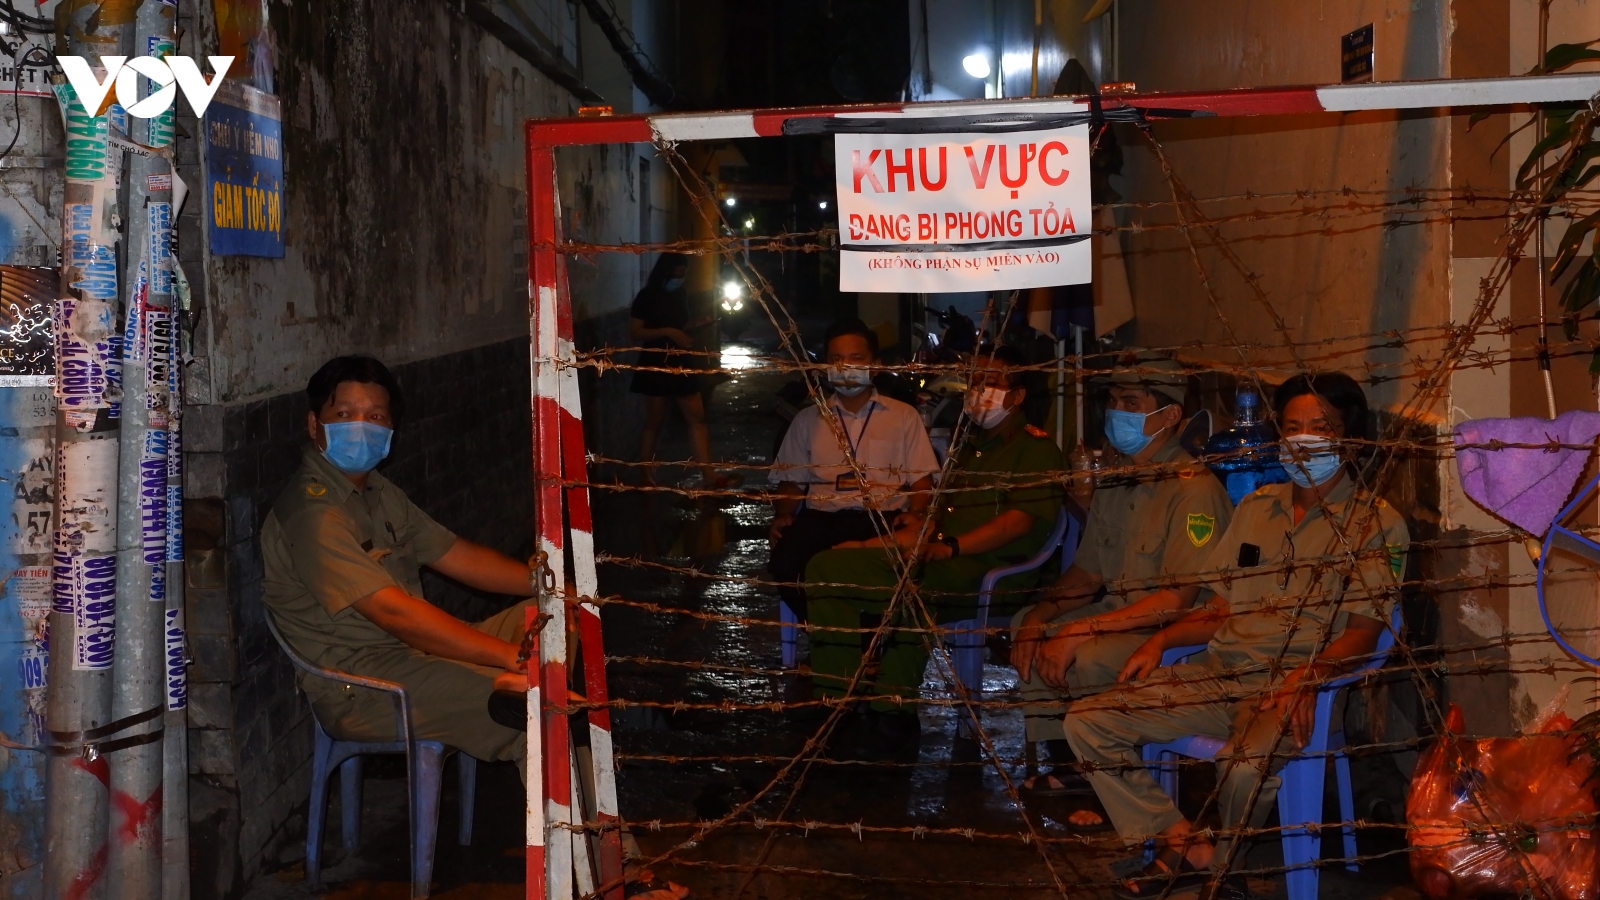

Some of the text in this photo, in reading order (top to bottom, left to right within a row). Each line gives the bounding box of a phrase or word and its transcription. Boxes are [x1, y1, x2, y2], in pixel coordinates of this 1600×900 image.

[264, 130, 279, 160] NHỎ
[852, 141, 1070, 199] KHU VỰC
[213, 165, 281, 242] GIẢM TỐC ĐỘ
[849, 201, 1077, 245] ĐANG BỊ PHONG TỎA
[868, 255, 922, 271] (KHÔNG
[1025, 250, 1060, 265] VÀO)
[75, 594, 83, 628] HẦM
